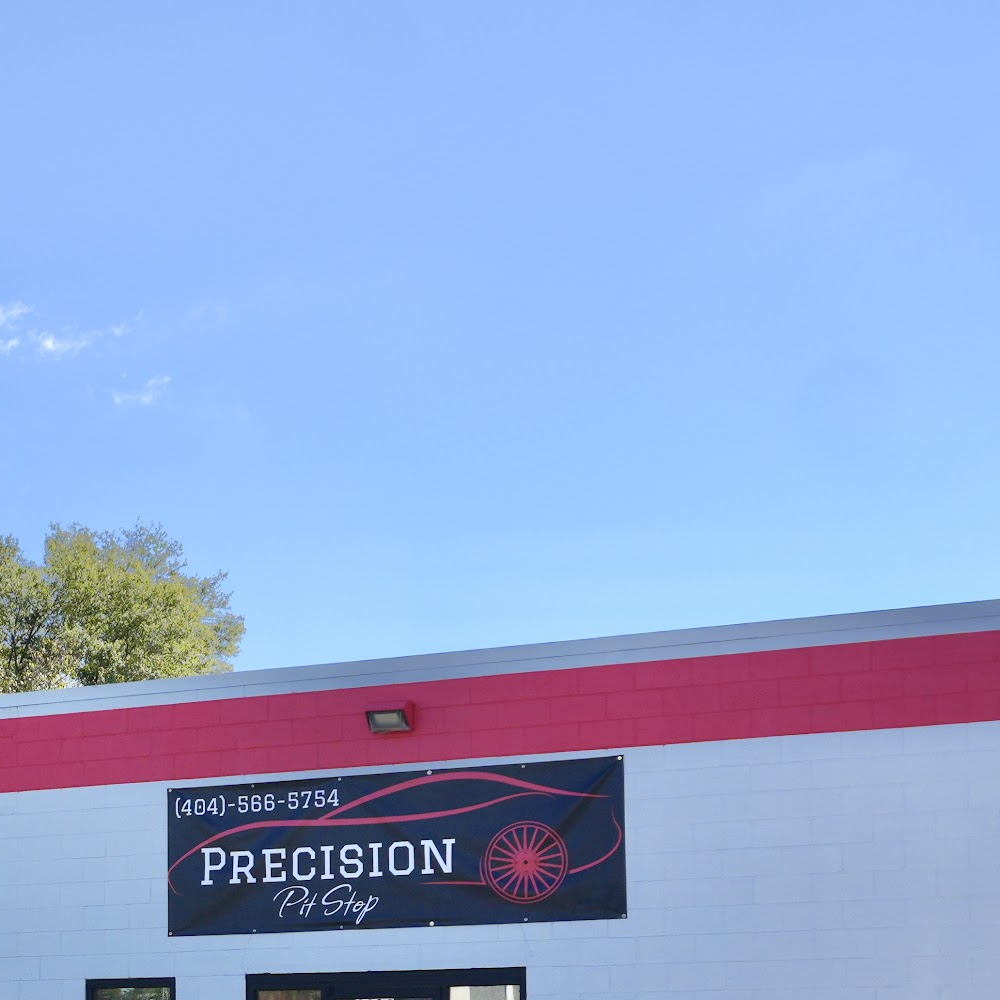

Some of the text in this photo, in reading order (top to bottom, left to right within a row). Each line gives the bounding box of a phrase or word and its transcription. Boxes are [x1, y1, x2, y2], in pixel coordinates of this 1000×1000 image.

[175, 788, 340, 819] (404)-566-5754
[200, 838, 456, 886] PRECISION
[273, 883, 380, 925] Pit Stop
